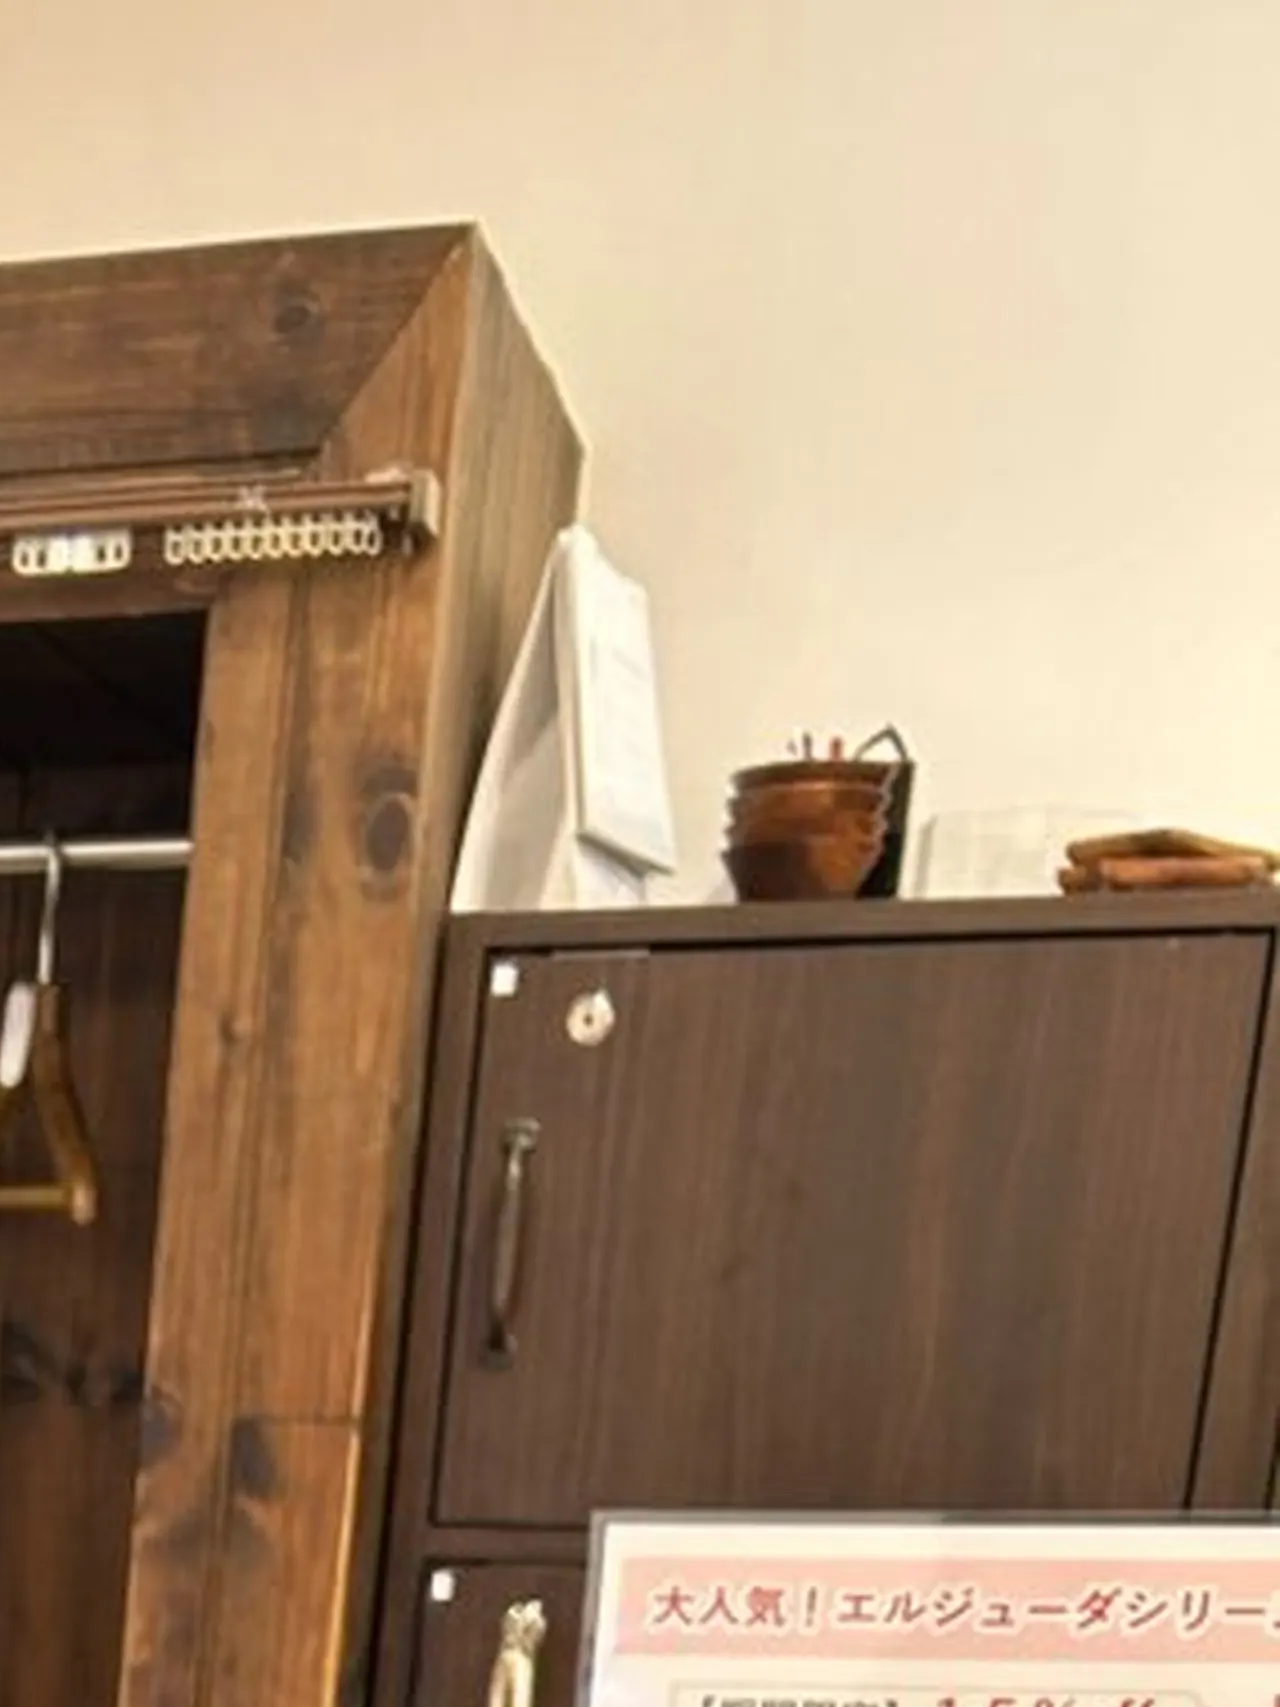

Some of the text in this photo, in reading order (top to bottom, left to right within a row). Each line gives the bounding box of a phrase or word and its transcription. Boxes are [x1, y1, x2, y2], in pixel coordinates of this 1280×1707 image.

[653, 1586, 1280, 1631] 大人気！エルジューダシリー
